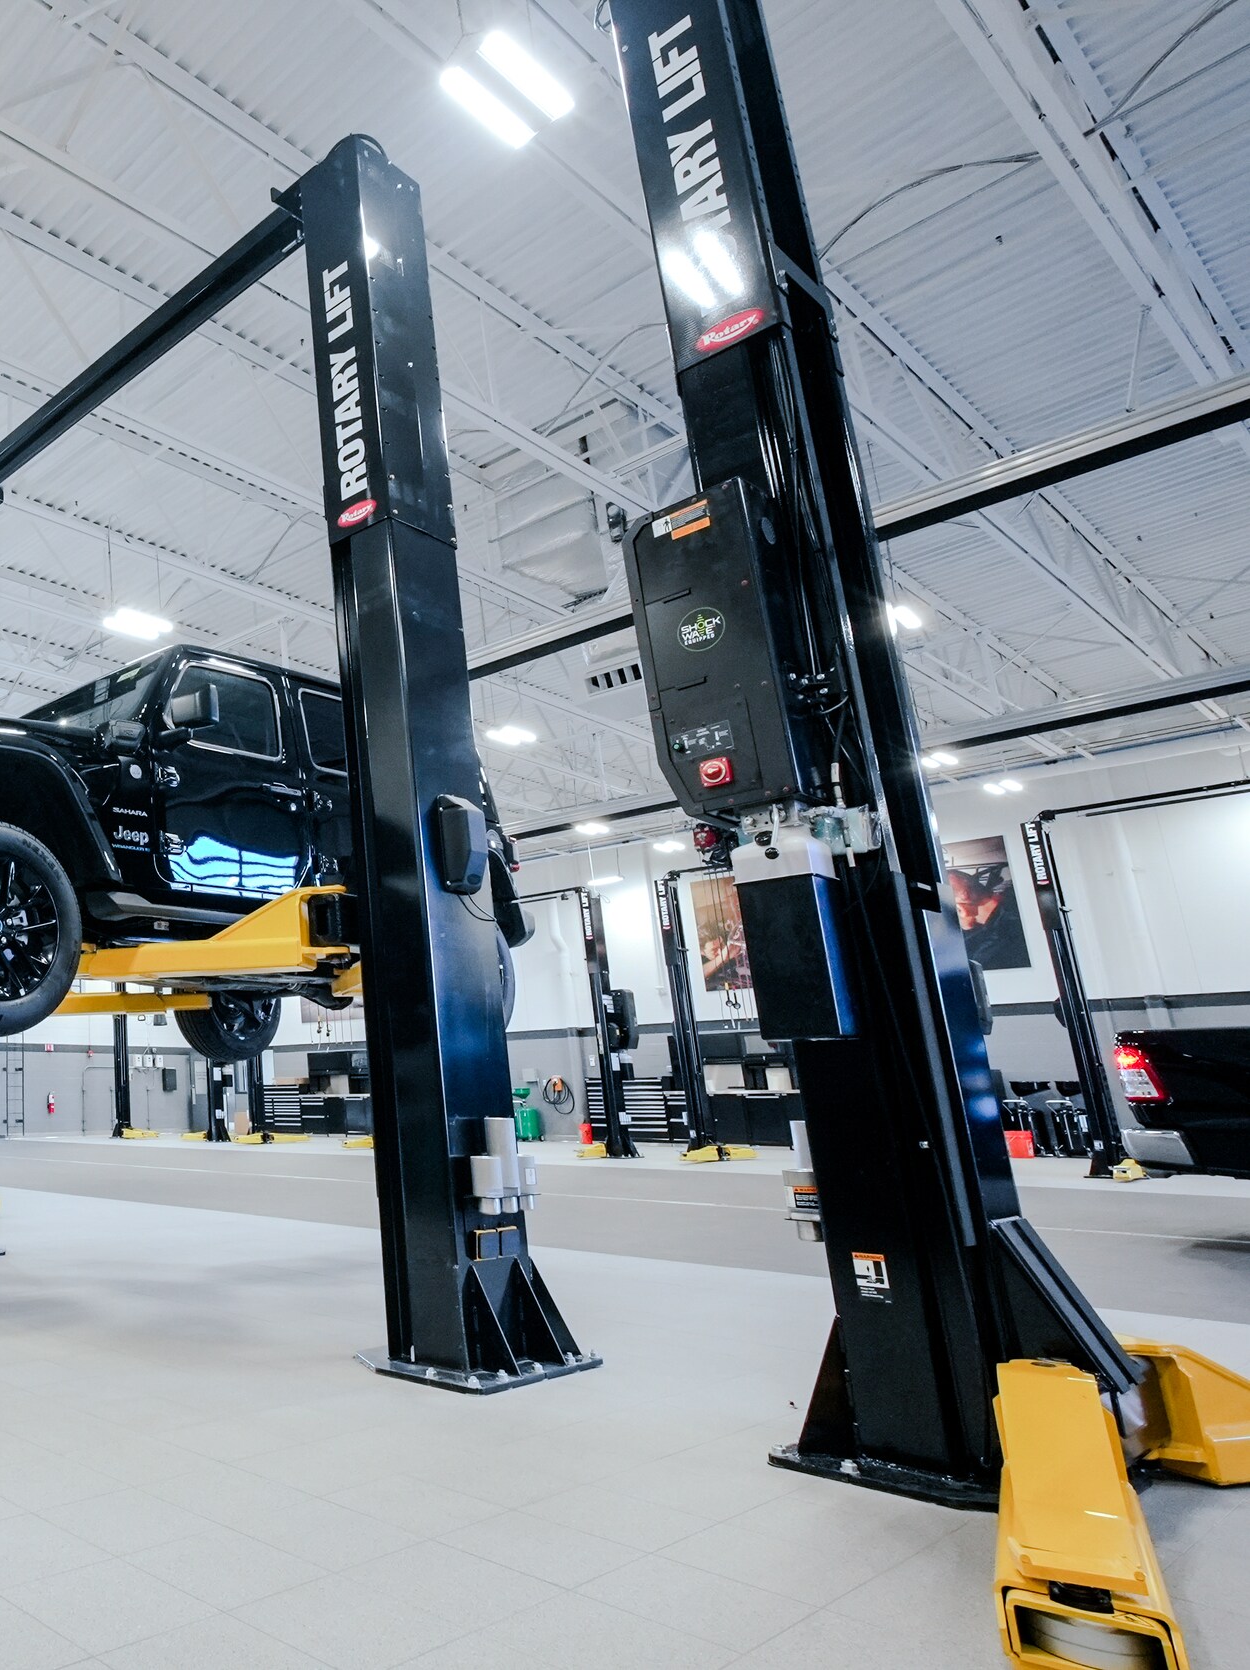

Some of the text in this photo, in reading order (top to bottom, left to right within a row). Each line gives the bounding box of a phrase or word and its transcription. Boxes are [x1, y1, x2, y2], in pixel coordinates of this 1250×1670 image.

[648, 15, 706, 123] LIFT
[702, 314, 758, 346] Rotary
[322, 260, 369, 501] ROTARY LIFT
[681, 616, 721, 634] SHOCK
[112, 806, 148, 817] SAHARA
[113, 825, 150, 846] Jeep
[1024, 823, 1047, 880] ROTARY LIFT
[580, 892, 593, 936] ROTARY LIFT
[657, 880, 670, 926] ROTARY LIFT
